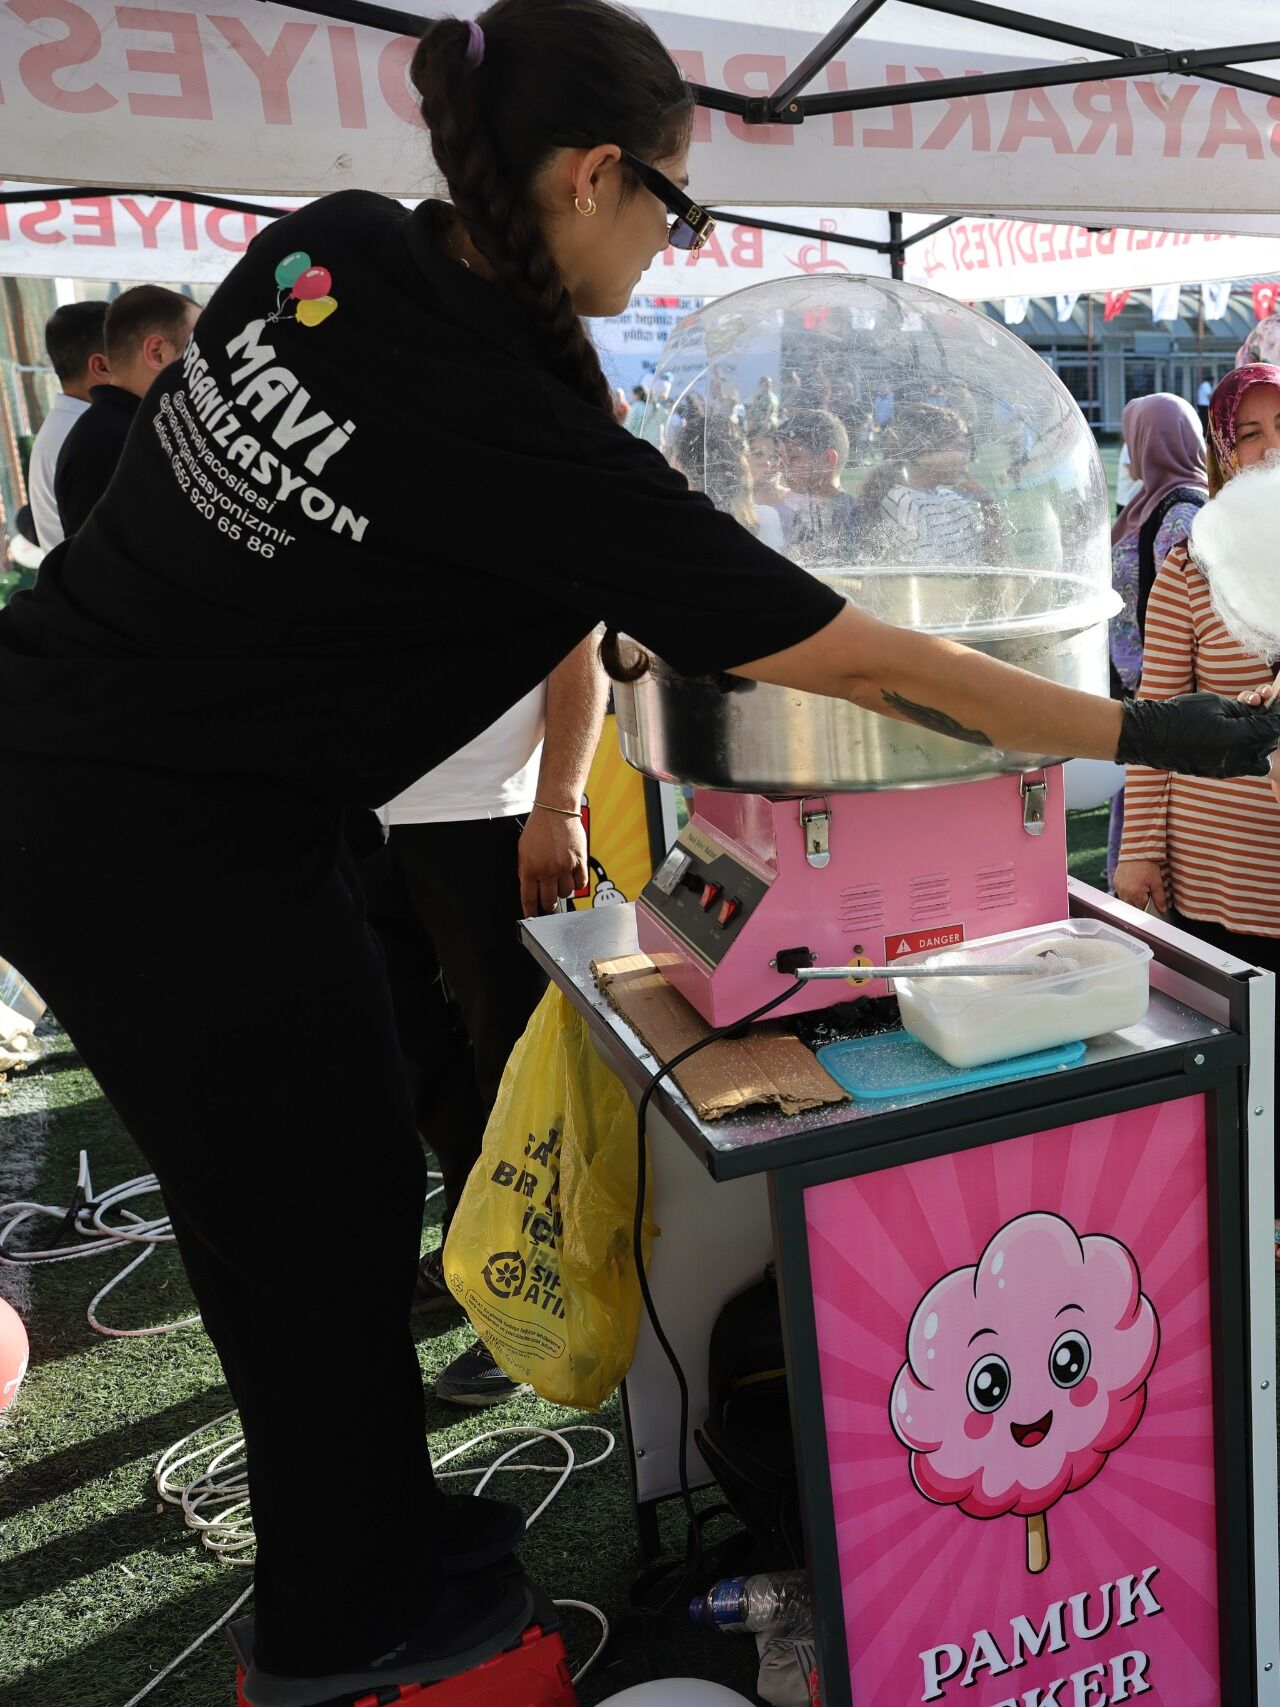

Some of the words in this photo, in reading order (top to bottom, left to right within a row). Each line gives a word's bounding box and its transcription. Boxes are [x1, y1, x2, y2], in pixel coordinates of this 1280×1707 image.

[226, 319, 356, 476] MAVİ
[172, 454, 191, 492] 0552
[190, 488, 215, 520] 920
[217, 516, 243, 540] 65
[246, 535, 276, 558] 86
[919, 933, 960, 948] DANGER
[918, 1565, 1166, 1704] PAMUK
